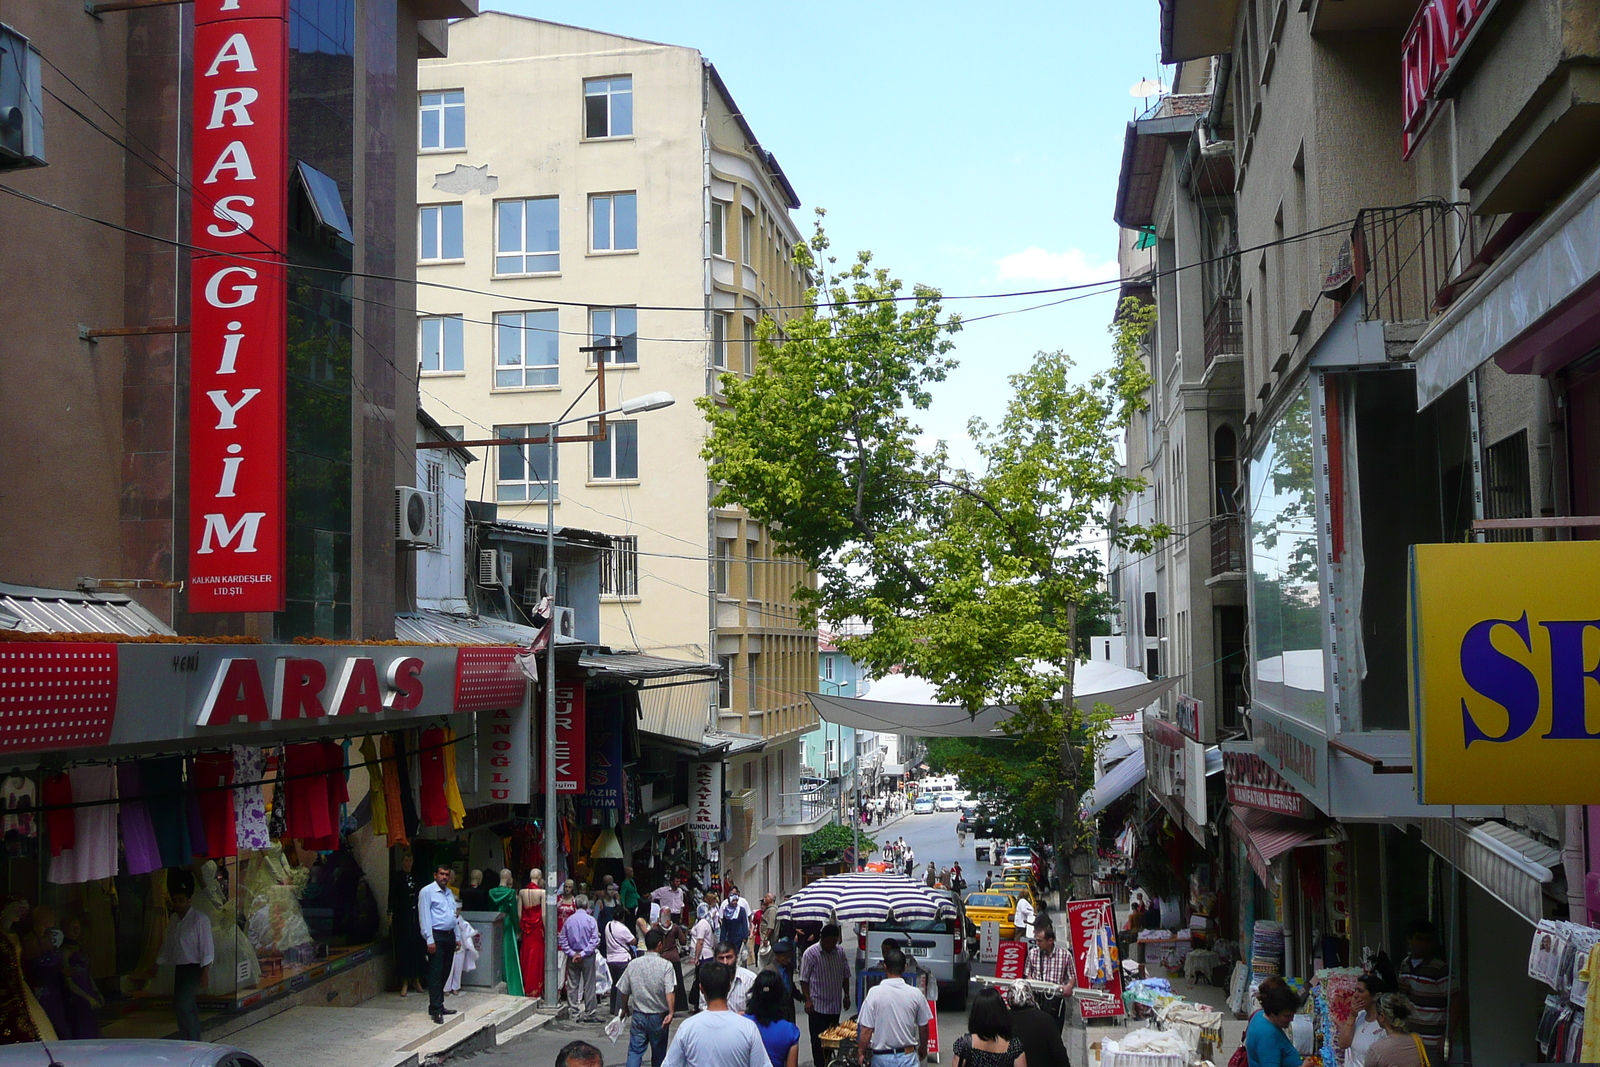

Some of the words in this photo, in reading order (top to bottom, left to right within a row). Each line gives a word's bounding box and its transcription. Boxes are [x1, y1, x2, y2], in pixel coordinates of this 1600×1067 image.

[192, 575, 220, 584] KALKAN
[221, 574, 272, 584] KARDEŞLER
[173, 650, 199, 672] YENİ
[196, 656, 425, 728] ARAS
[695, 764, 712, 822] AKÇAYLAR
[1268, 793, 1301, 814] MEFRUŞAT
